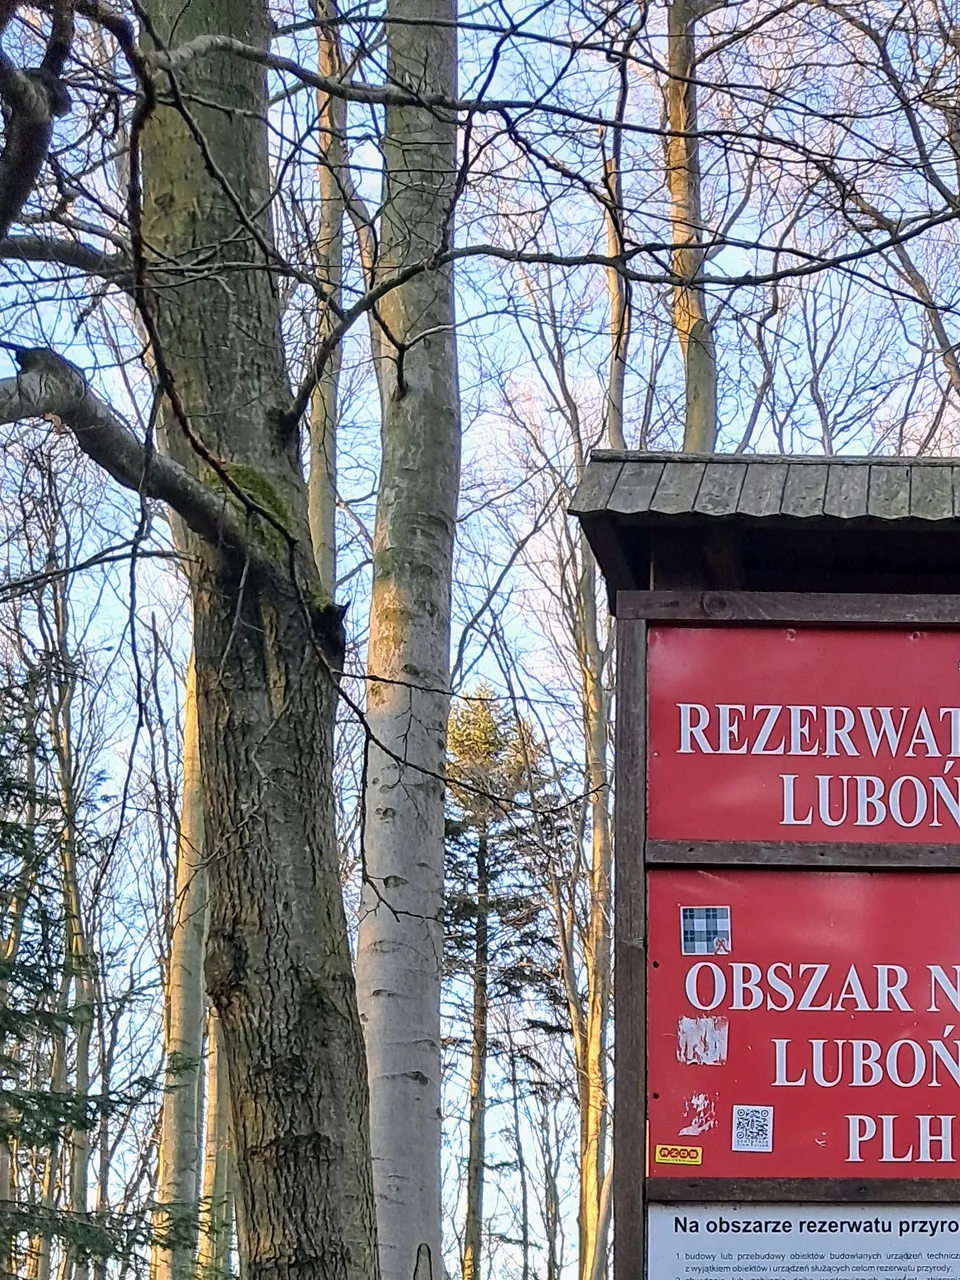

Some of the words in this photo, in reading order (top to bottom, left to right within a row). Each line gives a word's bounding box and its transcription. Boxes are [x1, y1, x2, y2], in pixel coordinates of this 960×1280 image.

[685, 961, 914, 1012] OBSZAR
[674, 1217, 699, 1232] Na
[706, 1217, 792, 1232] obszarze
[799, 1217, 892, 1233] rezerwatu
